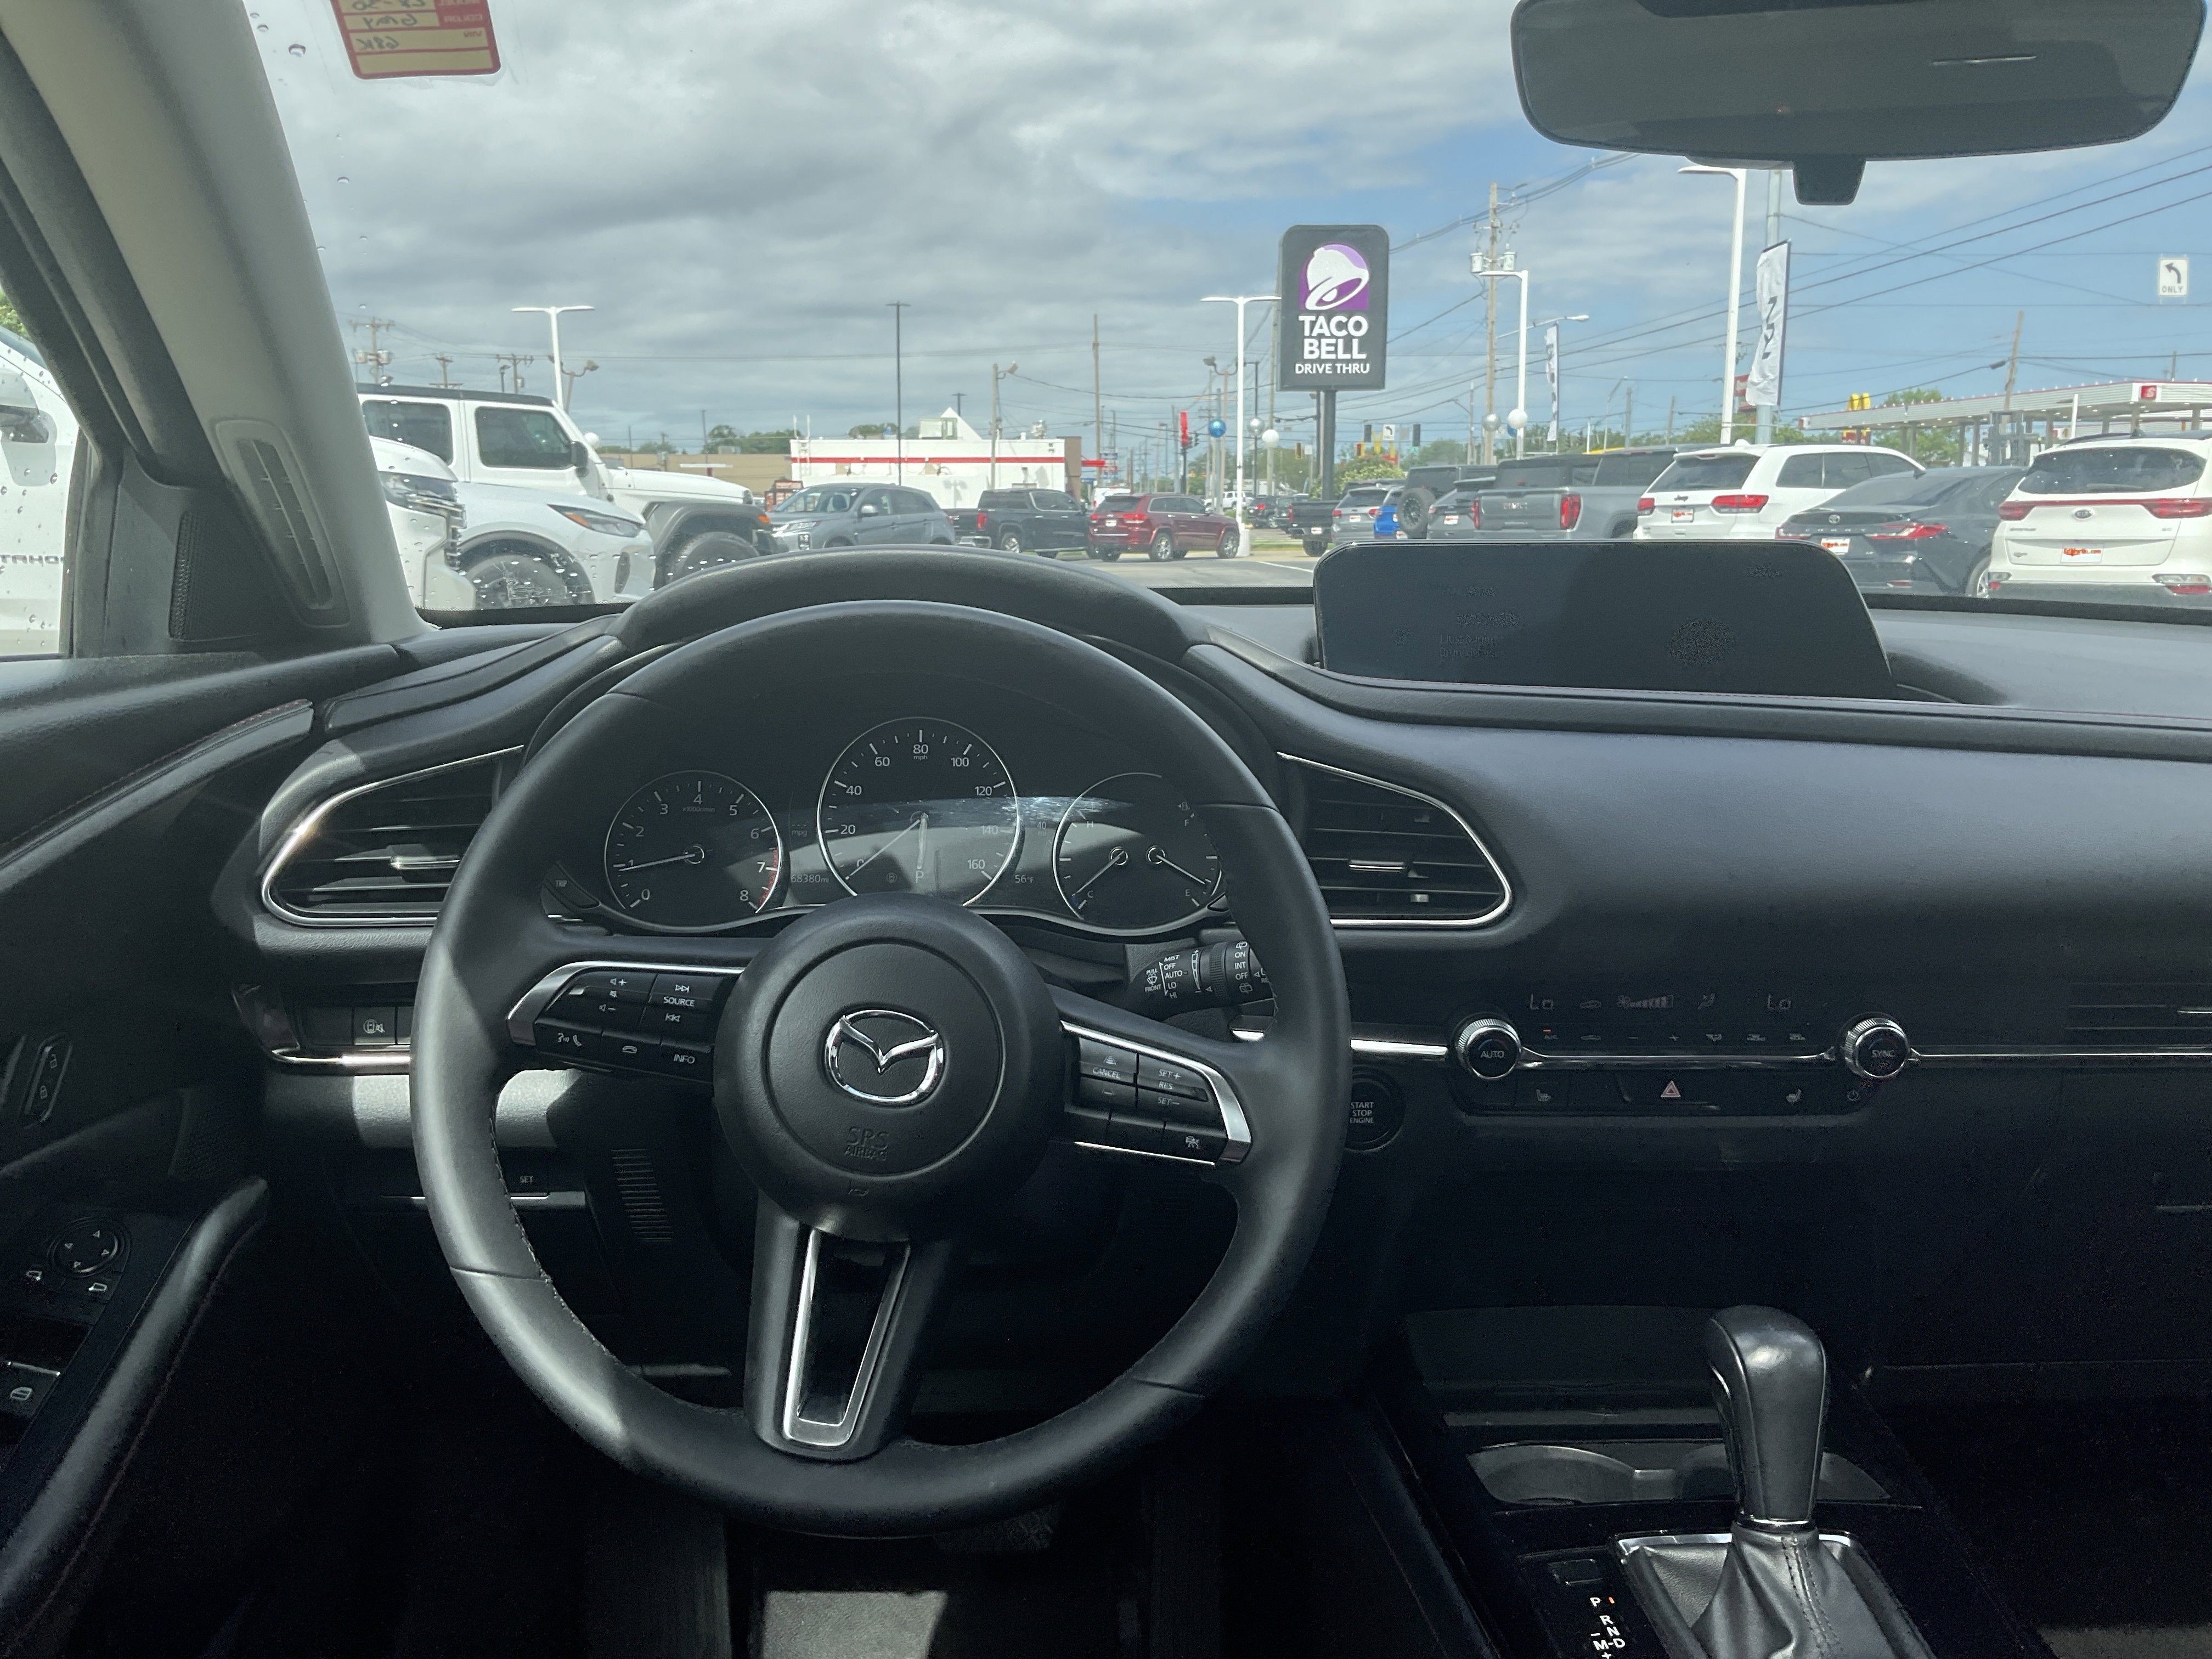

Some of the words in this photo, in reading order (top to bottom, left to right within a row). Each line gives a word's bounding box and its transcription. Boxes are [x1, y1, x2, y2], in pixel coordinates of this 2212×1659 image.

[2162, 285, 2183, 294] ONLY
[1298, 315, 1368, 336] TACO
[1304, 338, 1367, 359] BELL
[1295, 363, 1333, 374] DRIVE
[1335, 363, 1370, 374] THRU
[0, 555, 64, 565] TAHO
[913, 744, 929, 754] 80
[874, 757, 890, 767] 60
[951, 757, 969, 767] 100
[846, 786, 862, 795] 40
[975, 786, 992, 796] 120
[693, 794, 702, 804] 4
[660, 804, 668, 815] 3
[729, 805, 738, 816] 5
[635, 826, 644, 837] 2
[751, 828, 759, 839] 6
[840, 824, 856, 834] 20
[981, 825, 998, 835] 140
[757, 861, 765, 872] 7
[967, 859, 985, 870] 160
[915, 870, 924, 883] P
[641, 889, 650, 900] 0
[740, 889, 749, 901] 8
[1165, 970, 1183, 979] AUTO
[1144, 984, 1162, 992] FRONT
[663, 996, 695, 1007] SOURCE
[673, 1053, 695, 1064] INFO
[1480, 1049, 1505, 1058] AUTO
[1871, 1049, 1896, 1058] SYNC
[1092, 1066, 1121, 1079] CANCEL
[1159, 1081, 1173, 1090] RES
[520, 1175, 534, 1183] SET
[1590, 1597, 1601, 1607] P
[1600, 1615, 1614, 1625] R
[1606, 1626, 1620, 1637] N
